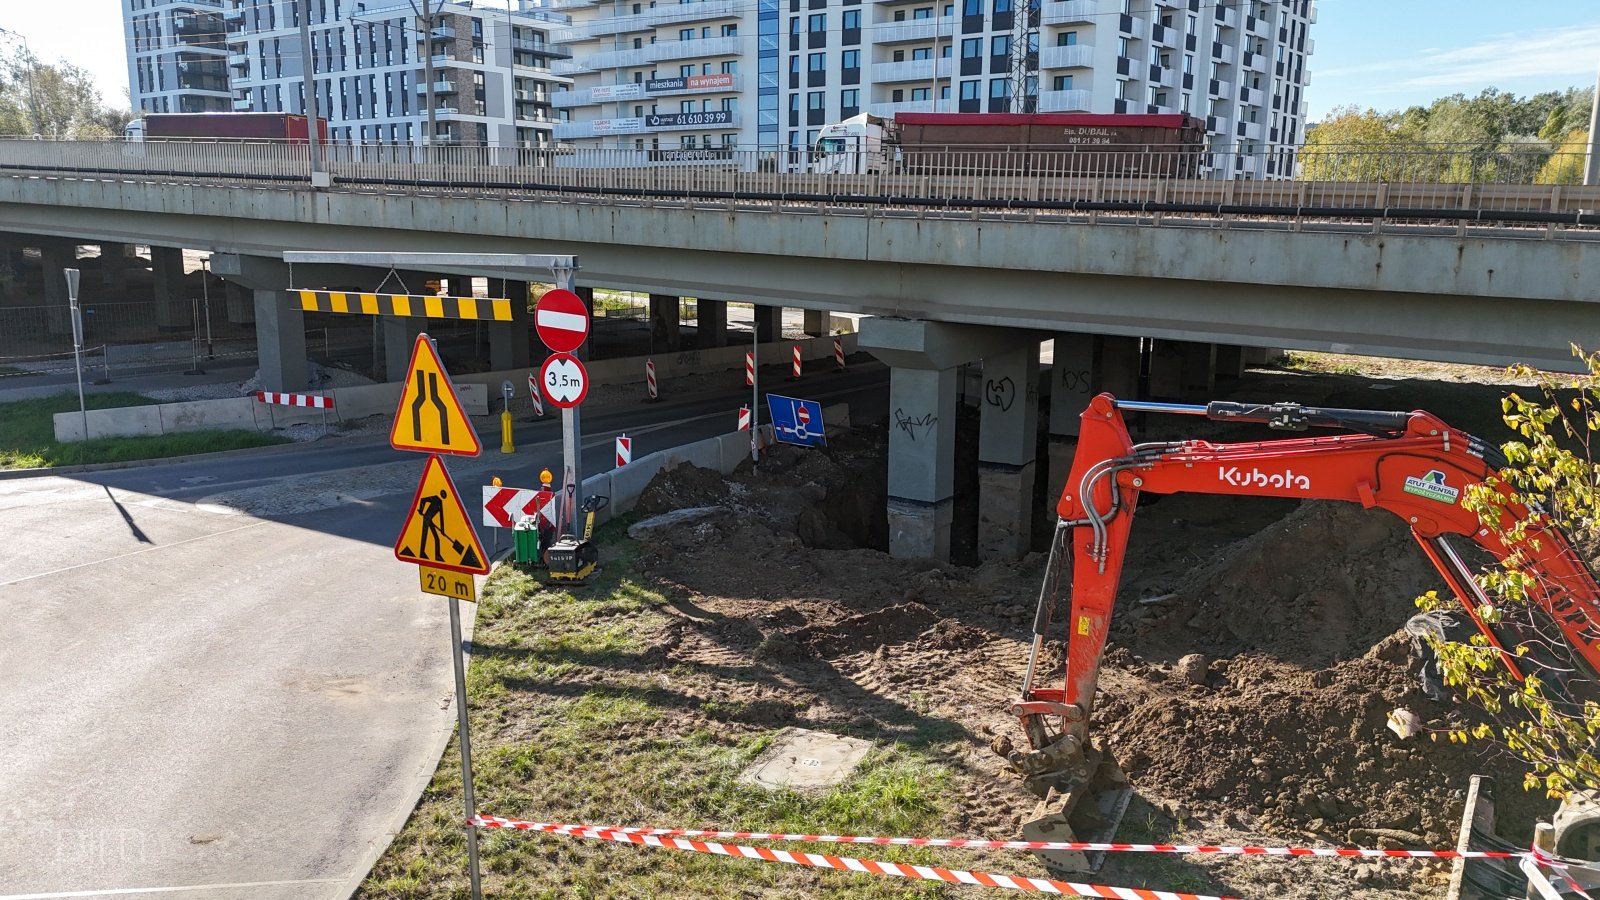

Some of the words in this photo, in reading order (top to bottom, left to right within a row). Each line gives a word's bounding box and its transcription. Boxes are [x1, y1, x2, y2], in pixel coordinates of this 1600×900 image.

[649, 80, 683, 89] mieszkania
[700, 76, 730, 86] wynajem
[676, 115, 686, 124] 61
[688, 114, 702, 124] 610
[704, 114, 714, 123] 39
[716, 112, 726, 122] 99
[1219, 466, 1310, 490] Kubota
[1407, 479, 1425, 488] ATUT
[1428, 484, 1456, 497] RENTAL
[427, 573, 446, 591] 20
[455, 581, 468, 597] m
